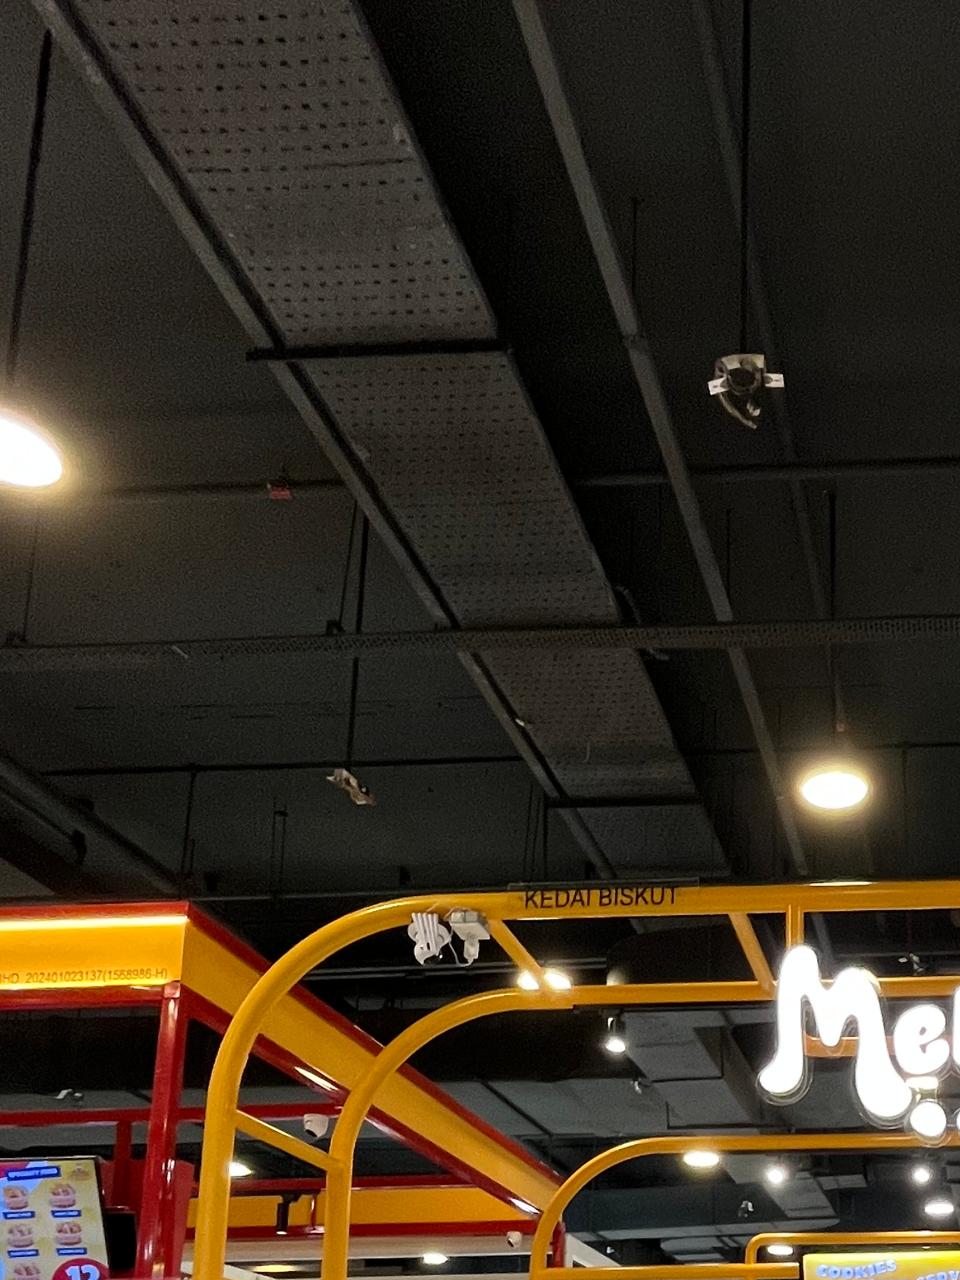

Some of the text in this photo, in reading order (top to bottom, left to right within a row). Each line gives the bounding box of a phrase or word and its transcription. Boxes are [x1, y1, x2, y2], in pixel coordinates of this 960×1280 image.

[524, 886, 678, 909] KEDAI BISKUT
[816, 1259, 897, 1280] COOKIES
